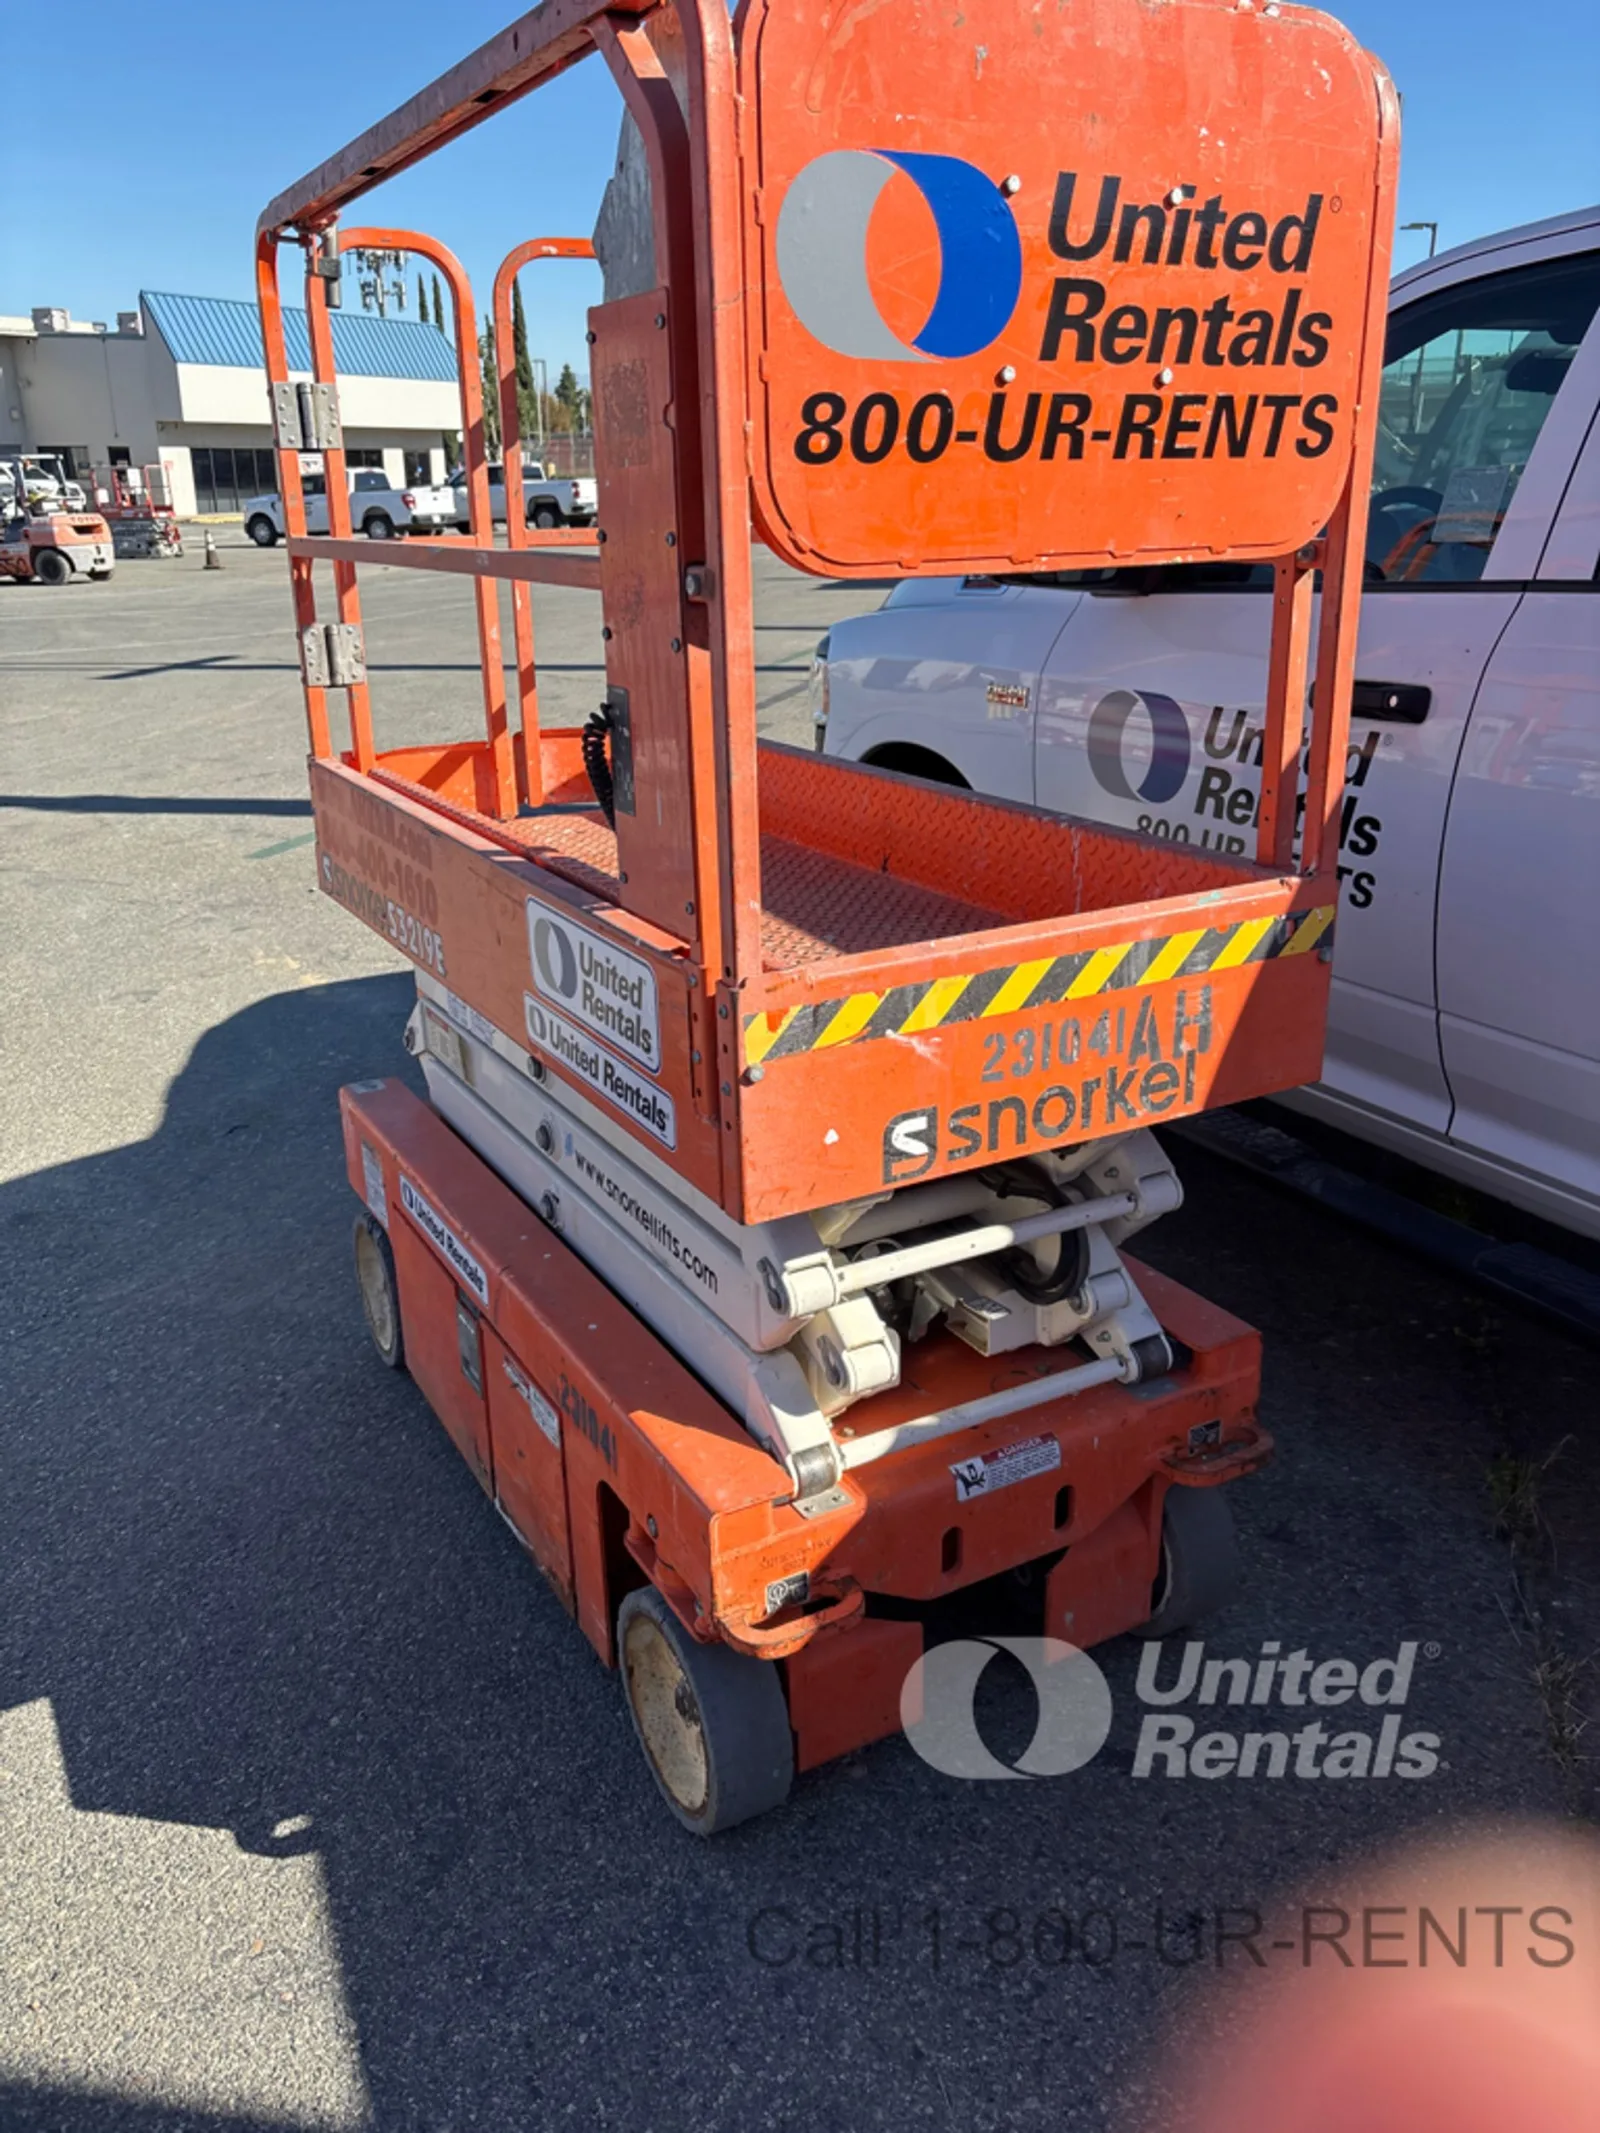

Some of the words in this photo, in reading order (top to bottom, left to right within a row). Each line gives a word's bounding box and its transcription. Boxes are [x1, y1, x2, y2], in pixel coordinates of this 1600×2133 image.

[1048, 171, 1323, 273] United
[1039, 278, 1333, 367] Rentals
[794, 392, 1338, 465] 800-UR-RENTS
[579, 940, 644, 1009] United
[582, 979, 652, 1052] Rentals
[549, 1018, 600, 1080] United
[603, 1060, 667, 1132] Rentals
[947, 1050, 1196, 1161] snorkel
[446, 1232, 484, 1292] Rentals
[574, 1149, 718, 1294] www.snorkellifts.com
